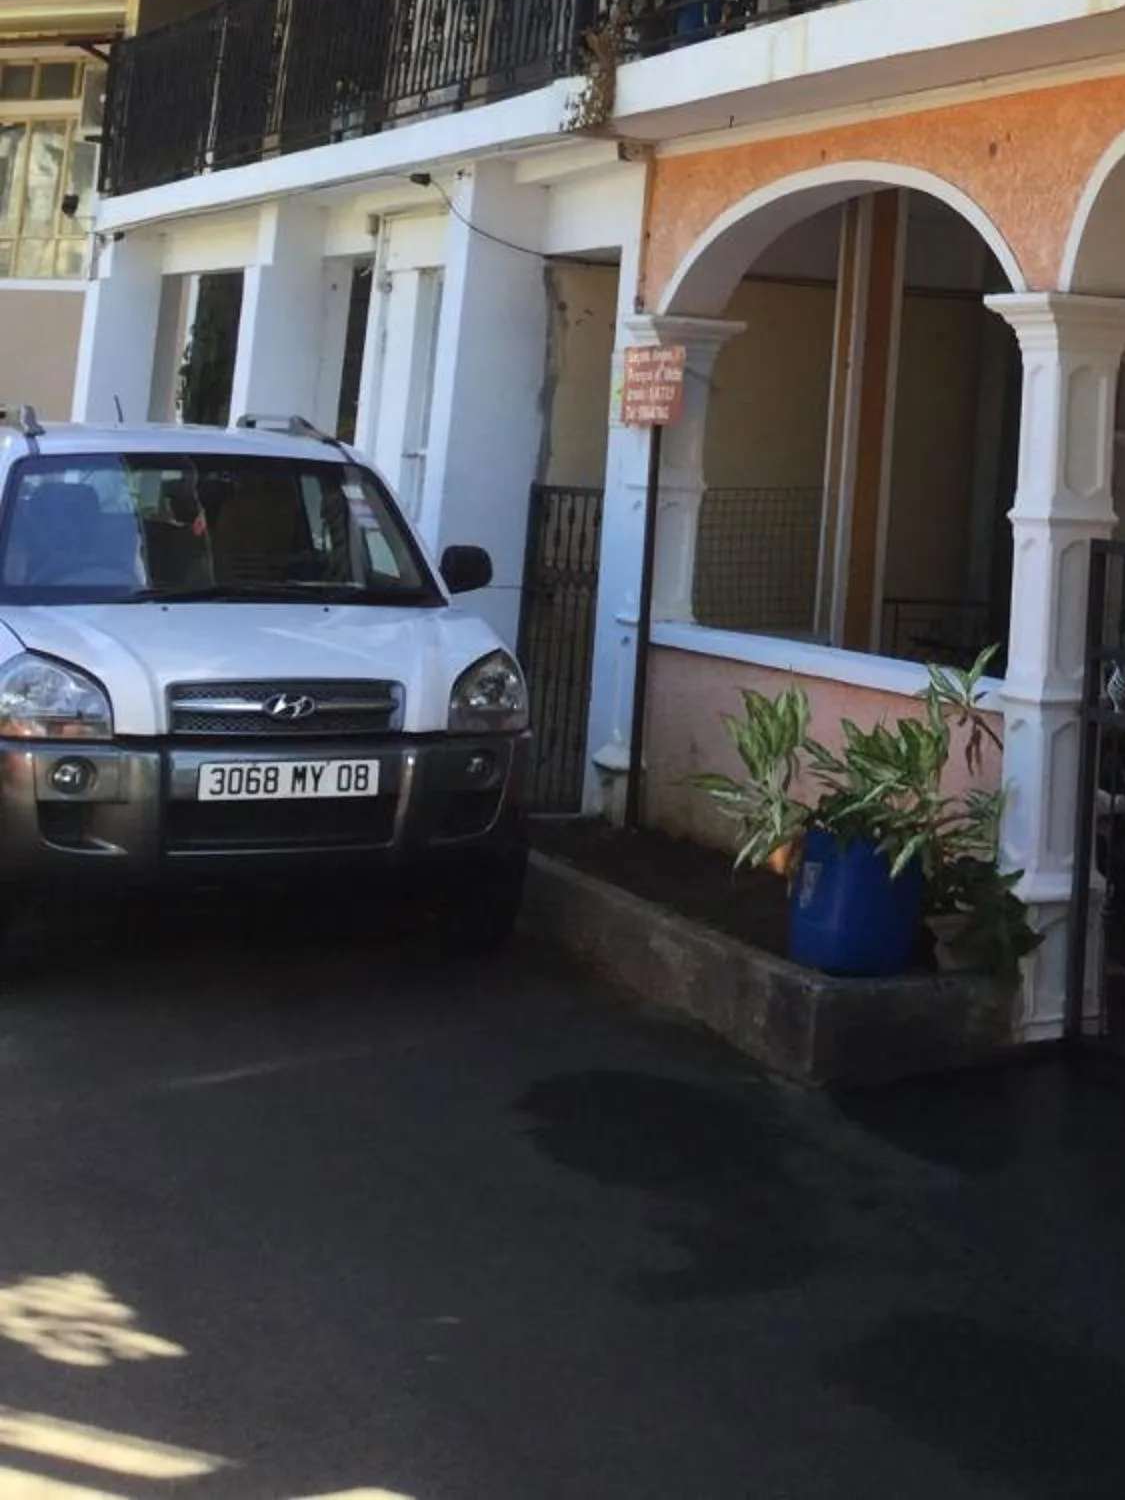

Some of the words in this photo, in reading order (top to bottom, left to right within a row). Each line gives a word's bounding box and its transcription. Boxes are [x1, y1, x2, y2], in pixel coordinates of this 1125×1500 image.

[209, 766, 280, 796] 3068
[291, 764, 325, 794] MY
[336, 763, 370, 793] 08
